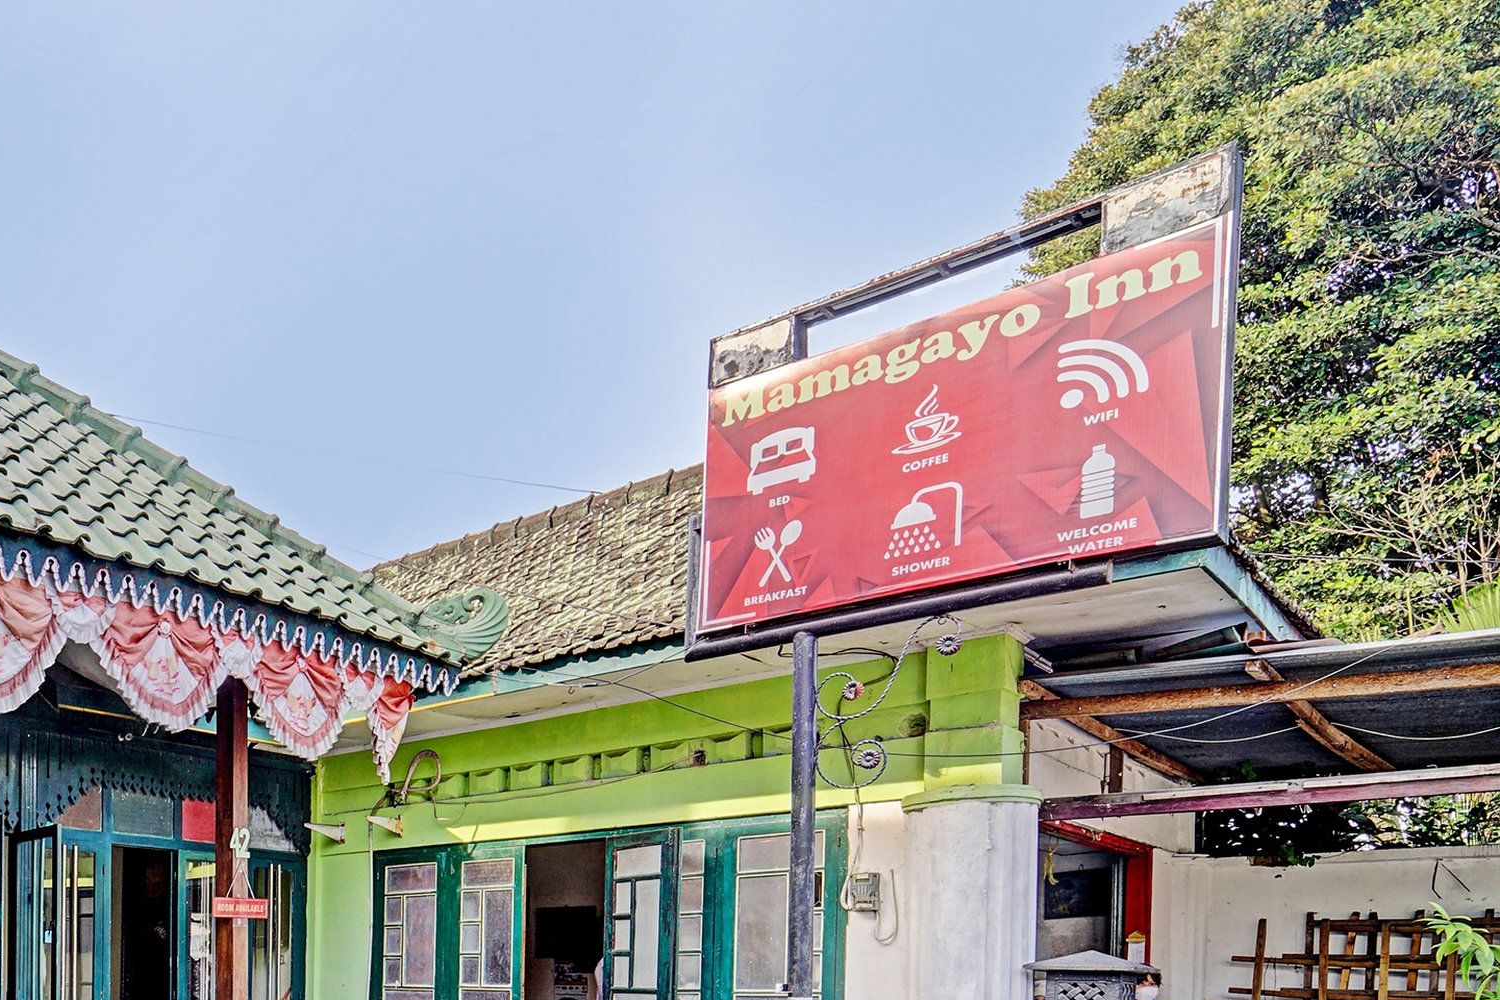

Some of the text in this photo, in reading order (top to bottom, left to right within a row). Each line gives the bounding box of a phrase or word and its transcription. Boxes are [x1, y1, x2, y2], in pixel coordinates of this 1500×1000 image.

[721, 250, 1202, 428] Mamagayo Inn
[1083, 408, 1119, 427] WIFI
[901, 453, 950, 474] COFFEE
[768, 494, 791, 508] BED
[1056, 517, 1138, 543] WELCOME
[1068, 536, 1124, 555] WATER
[891, 556, 951, 577] SHOWER
[743, 585, 807, 607] BREAKFAST
[229, 827, 251, 859] 42
